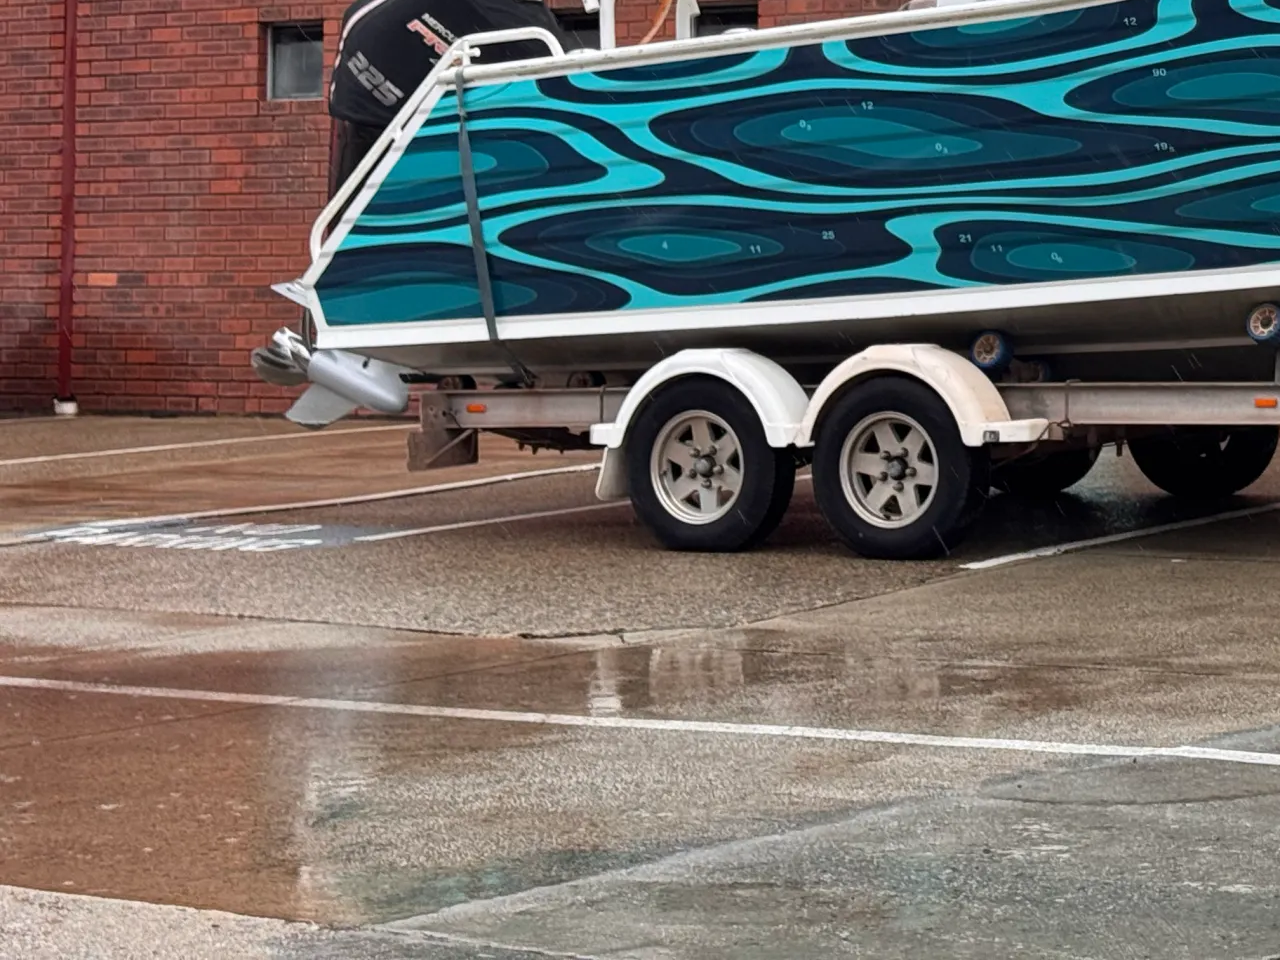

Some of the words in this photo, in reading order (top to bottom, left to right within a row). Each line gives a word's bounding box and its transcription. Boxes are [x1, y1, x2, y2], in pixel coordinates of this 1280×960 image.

[1123, 17, 1138, 27] 12
[347, 50, 405, 107] 225
[860, 101, 874, 110] 12
[958, 234, 972, 243] 21
[749, 244, 762, 254] 11
